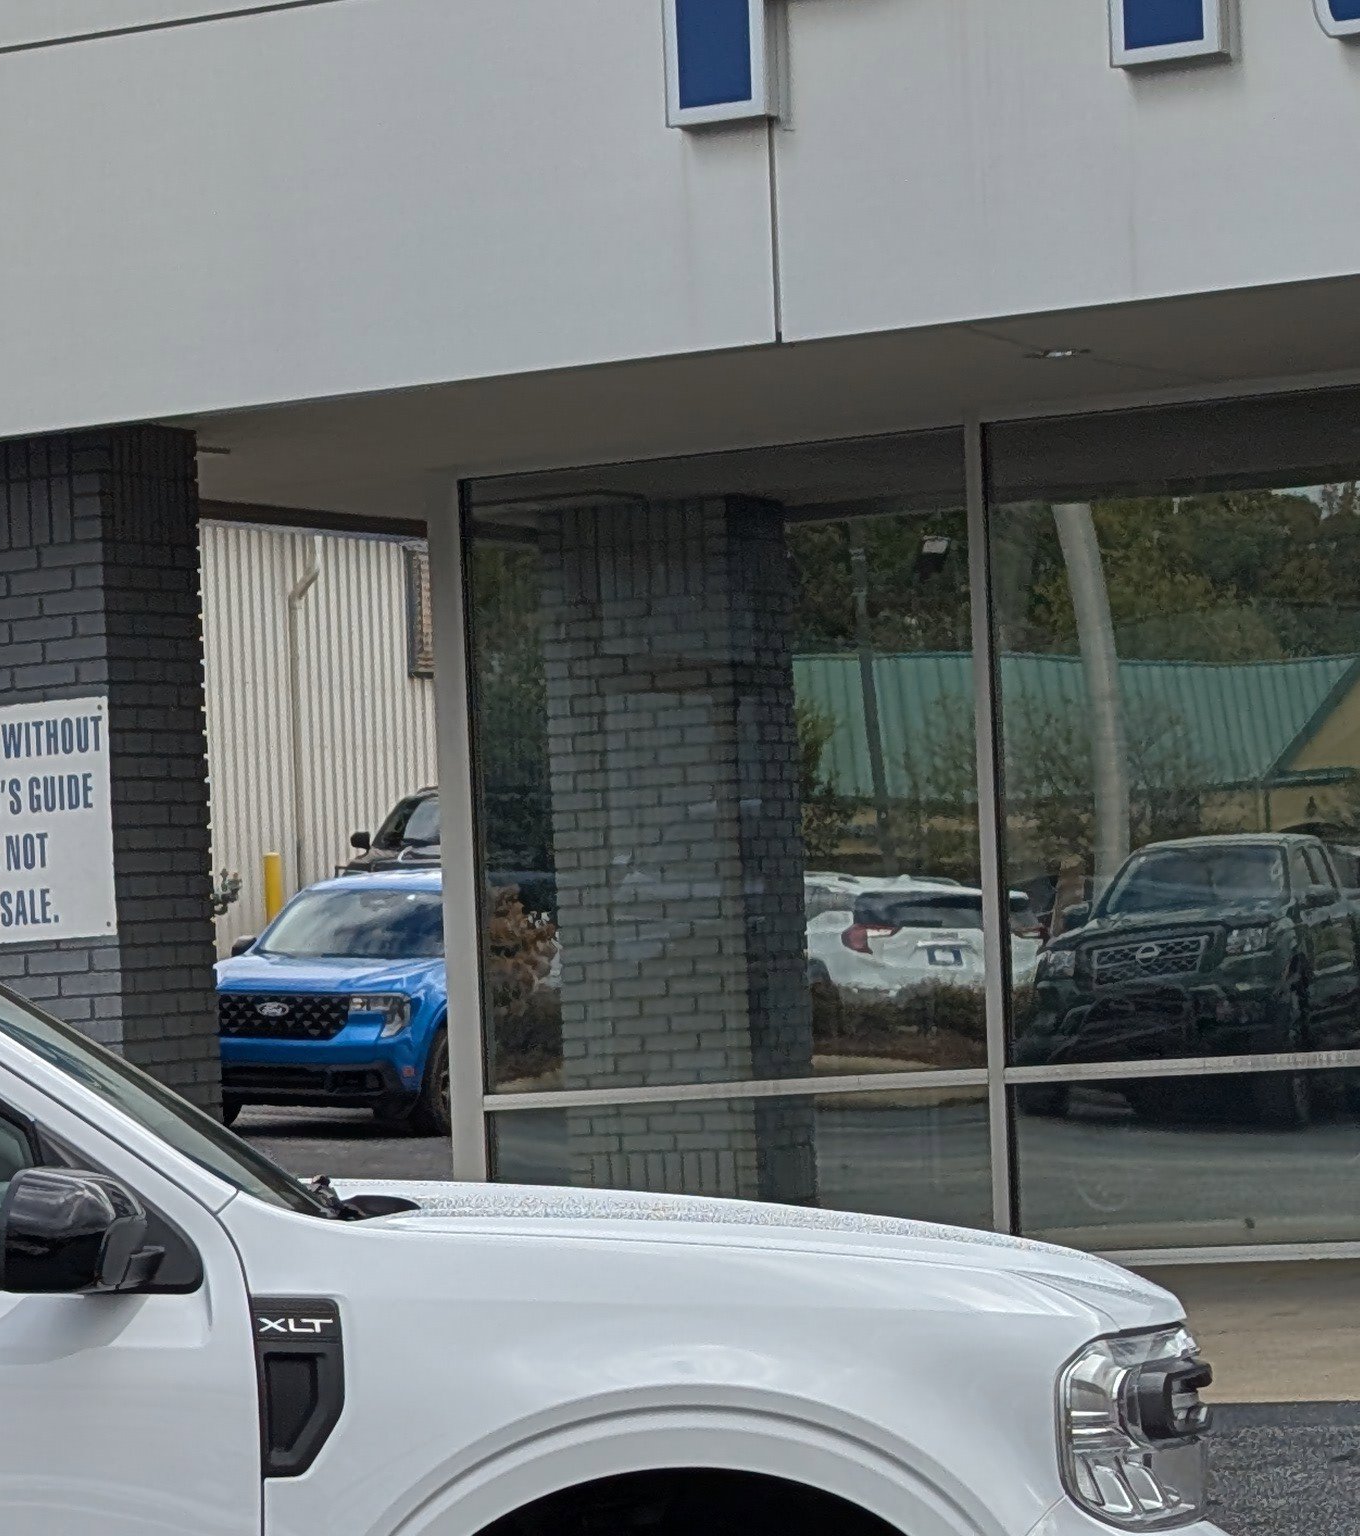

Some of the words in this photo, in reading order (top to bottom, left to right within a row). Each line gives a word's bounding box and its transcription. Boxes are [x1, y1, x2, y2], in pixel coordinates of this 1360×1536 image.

[1, 715, 103, 758] WITHOUT
[28, 773, 94, 814] GUIDE
[5, 832, 48, 872] NOT
[1, 888, 60, 927] SALE.
[258, 1318, 333, 1333] XLT
